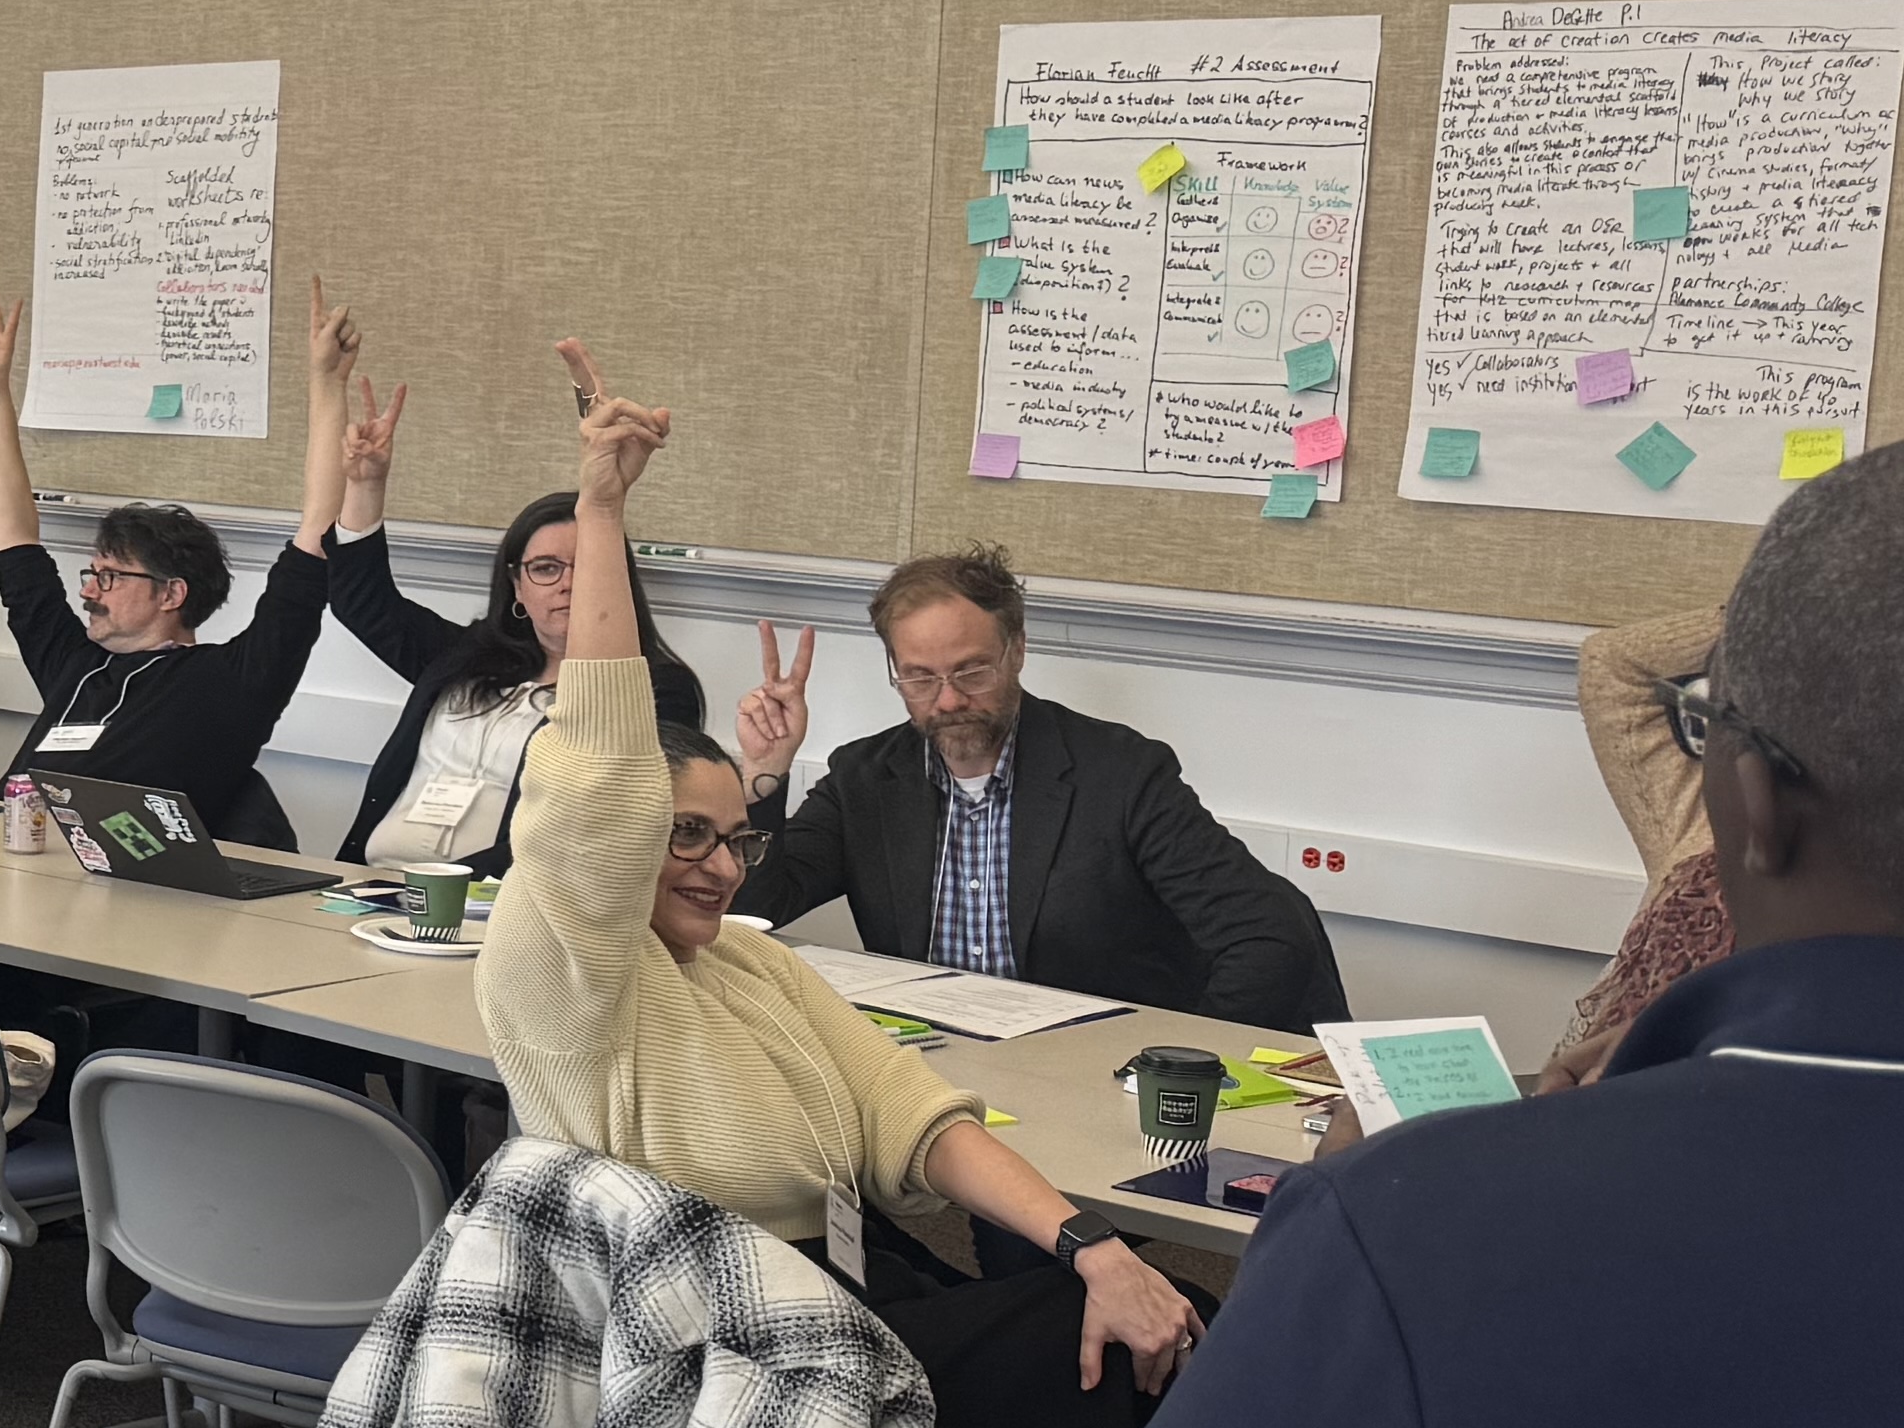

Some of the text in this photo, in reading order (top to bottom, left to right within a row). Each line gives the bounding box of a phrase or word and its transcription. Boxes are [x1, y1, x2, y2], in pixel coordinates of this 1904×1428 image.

[1503, 10, 1543, 30] Andrea
[1471, 33, 1495, 50] The
[1509, 35, 1528, 48] act
[1713, 32, 1763, 44] media
[1788, 30, 1852, 50] literacy
[1036, 63, 1095, 80] Florian
[1231, 54, 1340, 74] Assessment
[1020, 86, 1051, 105] How
[1055, 91, 1099, 105] should
[1117, 94, 1174, 106] student
[1187, 93, 1214, 105] look
[1256, 90, 1304, 108] after
[1029, 111, 1066, 127] they
[1075, 108, 1105, 122] have
[1193, 114, 1231, 124] media
[1216, 151, 1308, 171] Framework
[1015, 173, 1124, 190] How can news
[1012, 194, 1055, 206] media
[1117, 196, 1132, 209] be
[1562, 224, 1581, 234] an
[1014, 235, 1053, 250] What
[1082, 240, 1111, 255] the
[1024, 254, 1054, 270] alue
[1012, 301, 1040, 316] How
[1062, 308, 1087, 322] the
[1773, 316, 1803, 330] This
[1101, 327, 1137, 343] data
[1692, 333, 1715, 349] get
[1727, 329, 1741, 341] it
[1009, 340, 1060, 352] used to
[1024, 361, 1093, 374] education
[1023, 380, 1064, 392] media
[1756, 365, 1861, 395] This program
[186, 384, 236, 405] Maria
[1706, 382, 1731, 400] the
[1204, 400, 1247, 414] would
[1250, 400, 1280, 419] like
[1740, 403, 1754, 414] in
